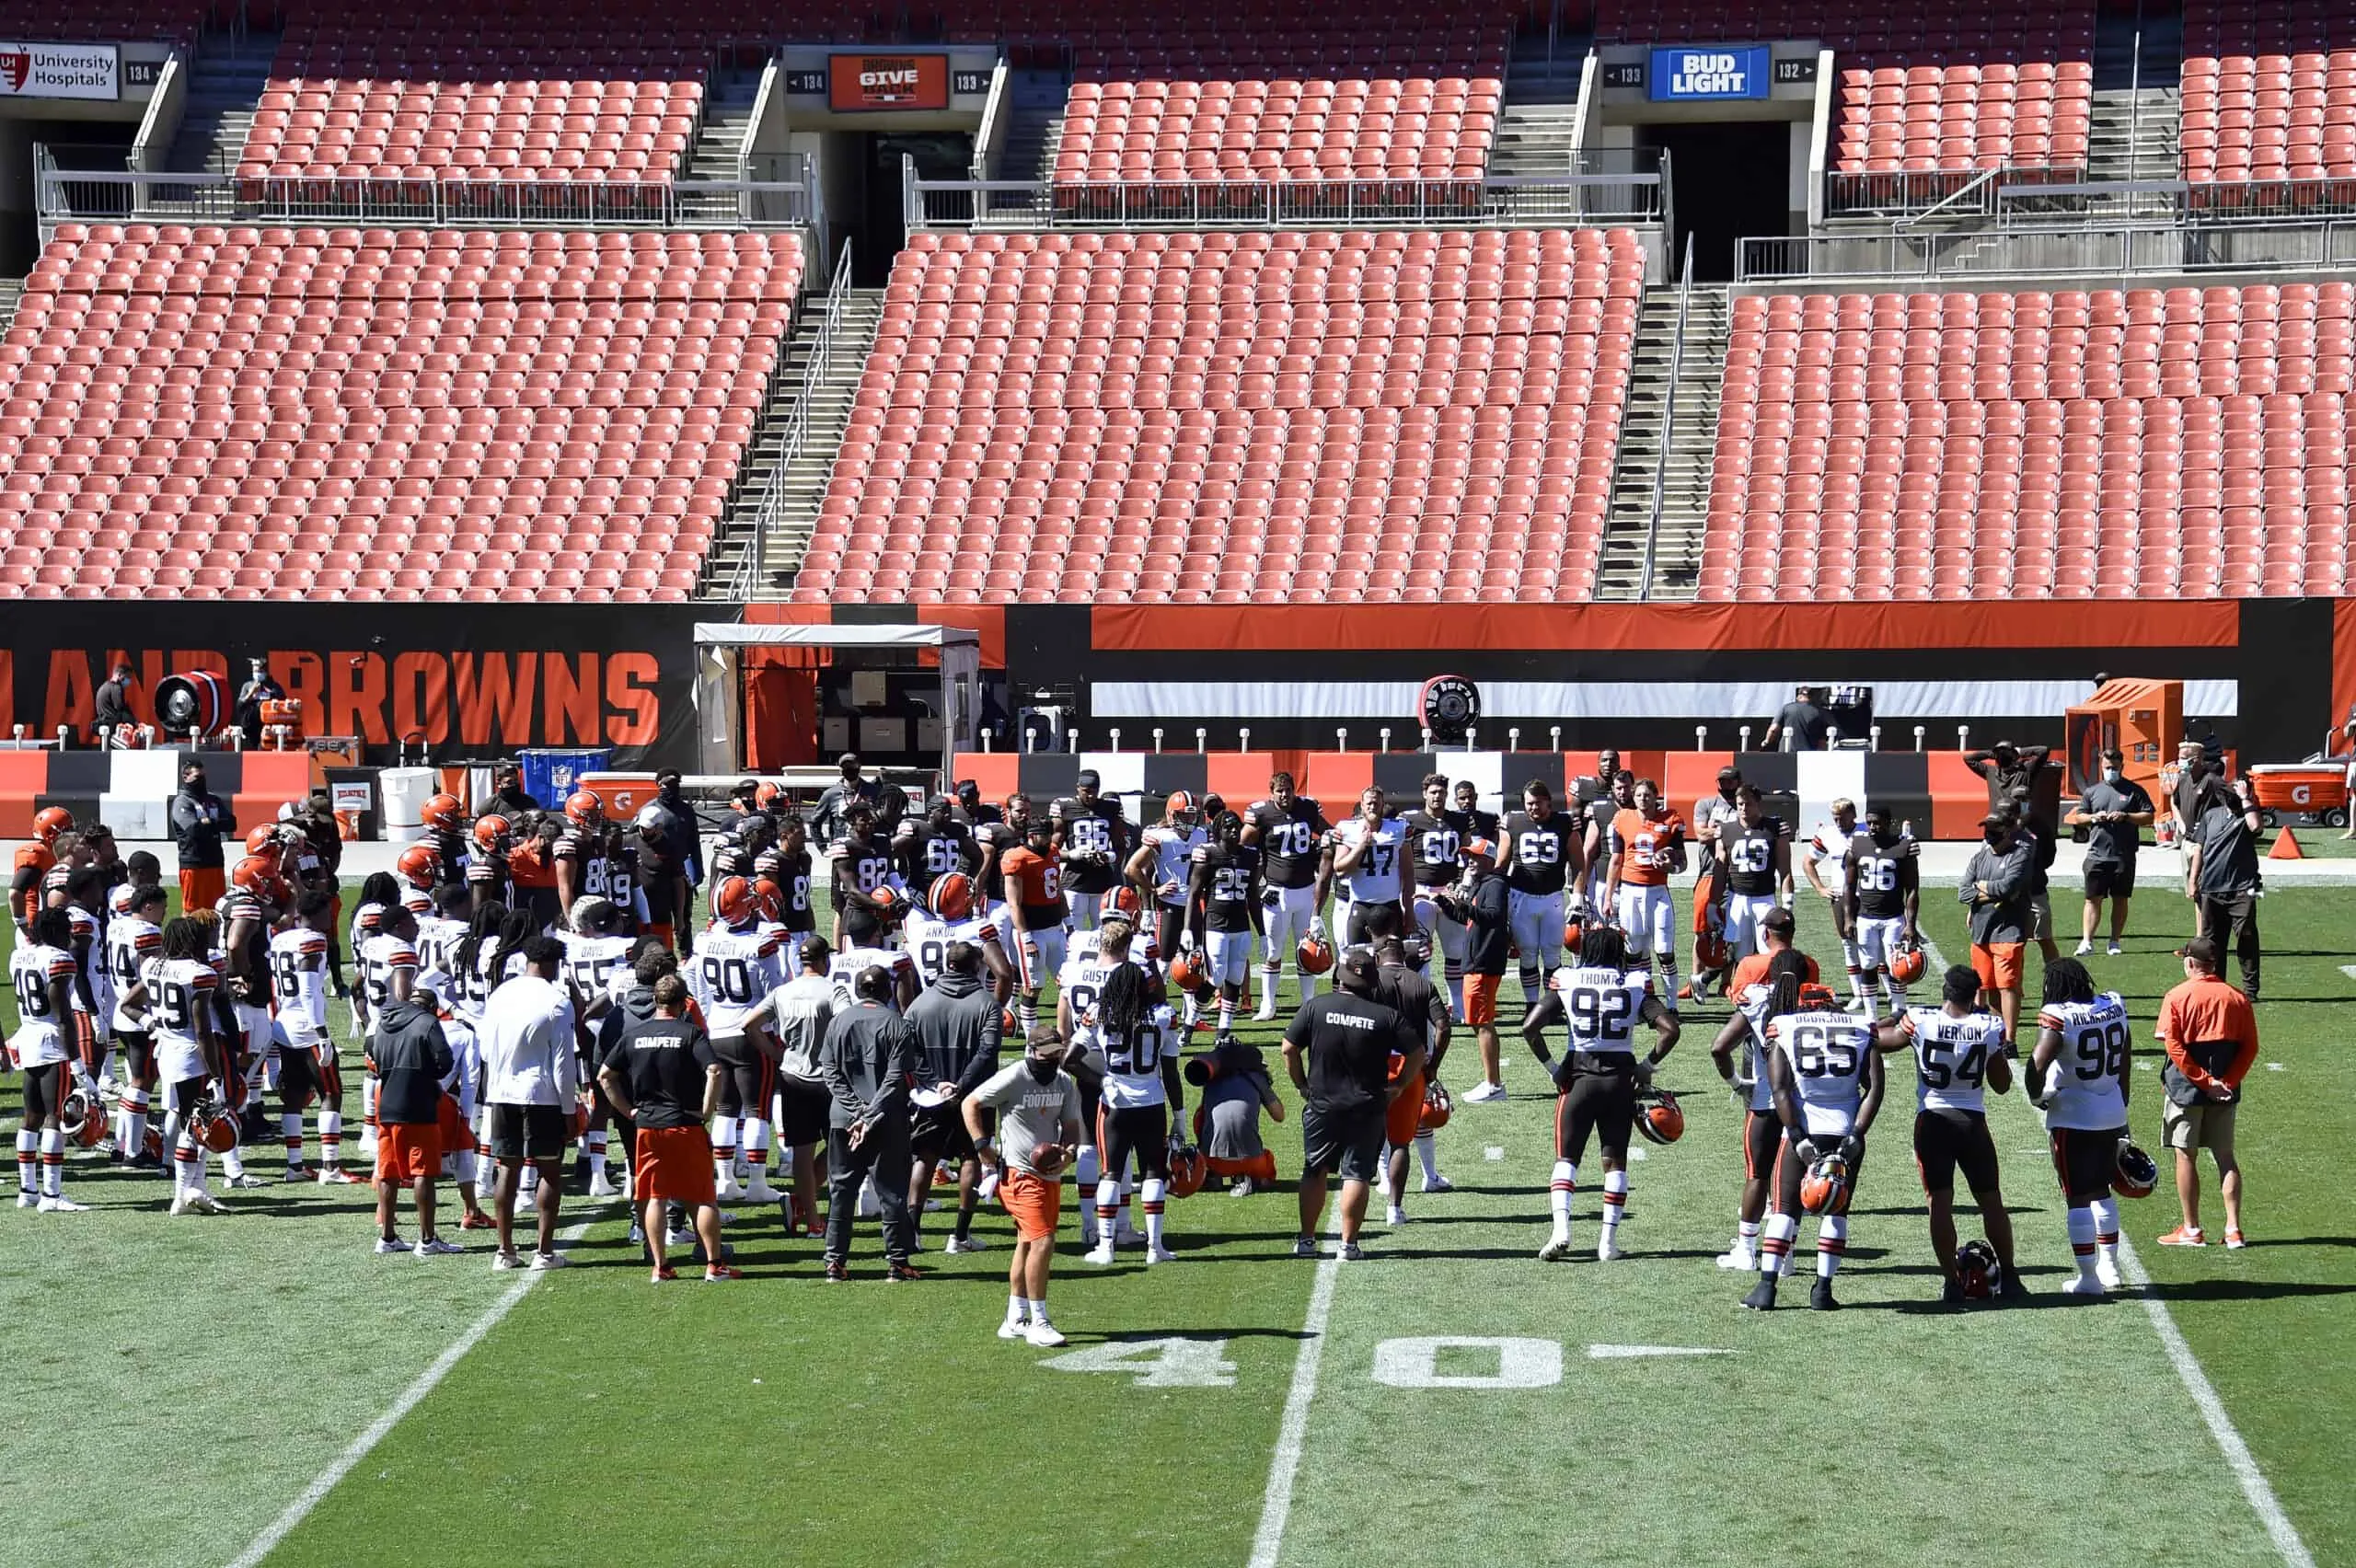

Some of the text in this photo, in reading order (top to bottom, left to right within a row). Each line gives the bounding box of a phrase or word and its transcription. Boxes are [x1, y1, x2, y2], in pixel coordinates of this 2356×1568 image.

[34, 53, 114, 73] University
[130, 66, 150, 81] 134
[1683, 55, 1736, 74] BUD
[1780, 63, 1799, 78] 132
[35, 71, 107, 88] Hospitals
[803, 75, 823, 89] 134
[860, 70, 918, 86] GIVE
[957, 75, 976, 89] 133
[1622, 68, 1641, 83] 133
[1672, 73, 1745, 93] LIGHT
[265, 650, 659, 745] BROWNS
[2292, 785, 2310, 804] G
[1073, 819, 1110, 851] 86
[1273, 821, 1311, 858] 78
[928, 839, 959, 872] 66
[1424, 831, 1460, 865] 60
[1519, 831, 1559, 864] 63
[1730, 838, 1769, 872] 43
[1361, 844, 1395, 876] 47
[858, 858, 889, 894] 82
[1215, 868, 1251, 901] 25
[1858, 856, 1896, 891] 36
[703, 957, 752, 1003] 90
[1580, 973, 1623, 986] THOMA
[1325, 1011, 1376, 1031] COMPETE
[1571, 987, 1633, 1040] 92
[2072, 1004, 2124, 1026] RICHARDSON
[1937, 1022, 1982, 1042] VERNON
[634, 1037, 682, 1050] COMPETE
[1794, 1025, 1857, 1078] 65
[2074, 1021, 2125, 1081] 98
[1921, 1038, 1987, 1090] 54
[1022, 1093, 1065, 1108] FOOTBALL
